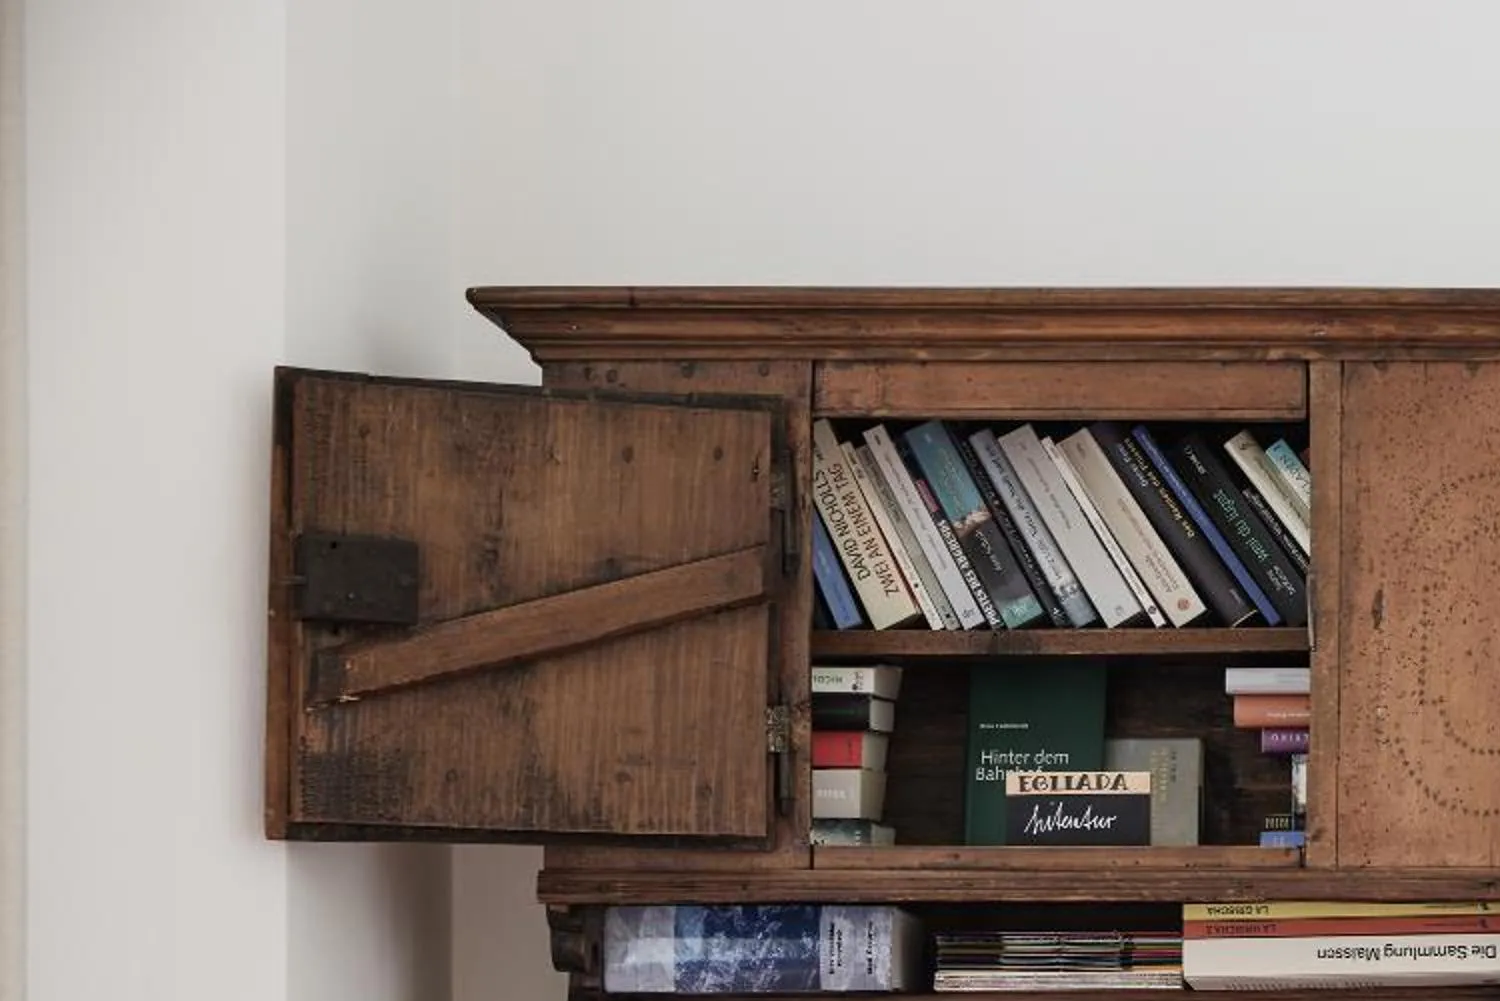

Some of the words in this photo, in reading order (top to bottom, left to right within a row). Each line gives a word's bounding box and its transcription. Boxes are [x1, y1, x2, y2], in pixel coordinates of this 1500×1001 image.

[825, 461, 852, 492] TAG
[813, 467, 855, 538] NICHOLLS
[836, 489, 873, 539] EINEM
[838, 536, 873, 582] DAVID
[860, 535, 883, 560] AN
[870, 559, 901, 598] ZWEI
[981, 748, 1031, 765] Hinter
[1034, 748, 1070, 765] dem
[1383, 943, 1468, 960] Sammlung
[1471, 944, 1498, 959] Die
